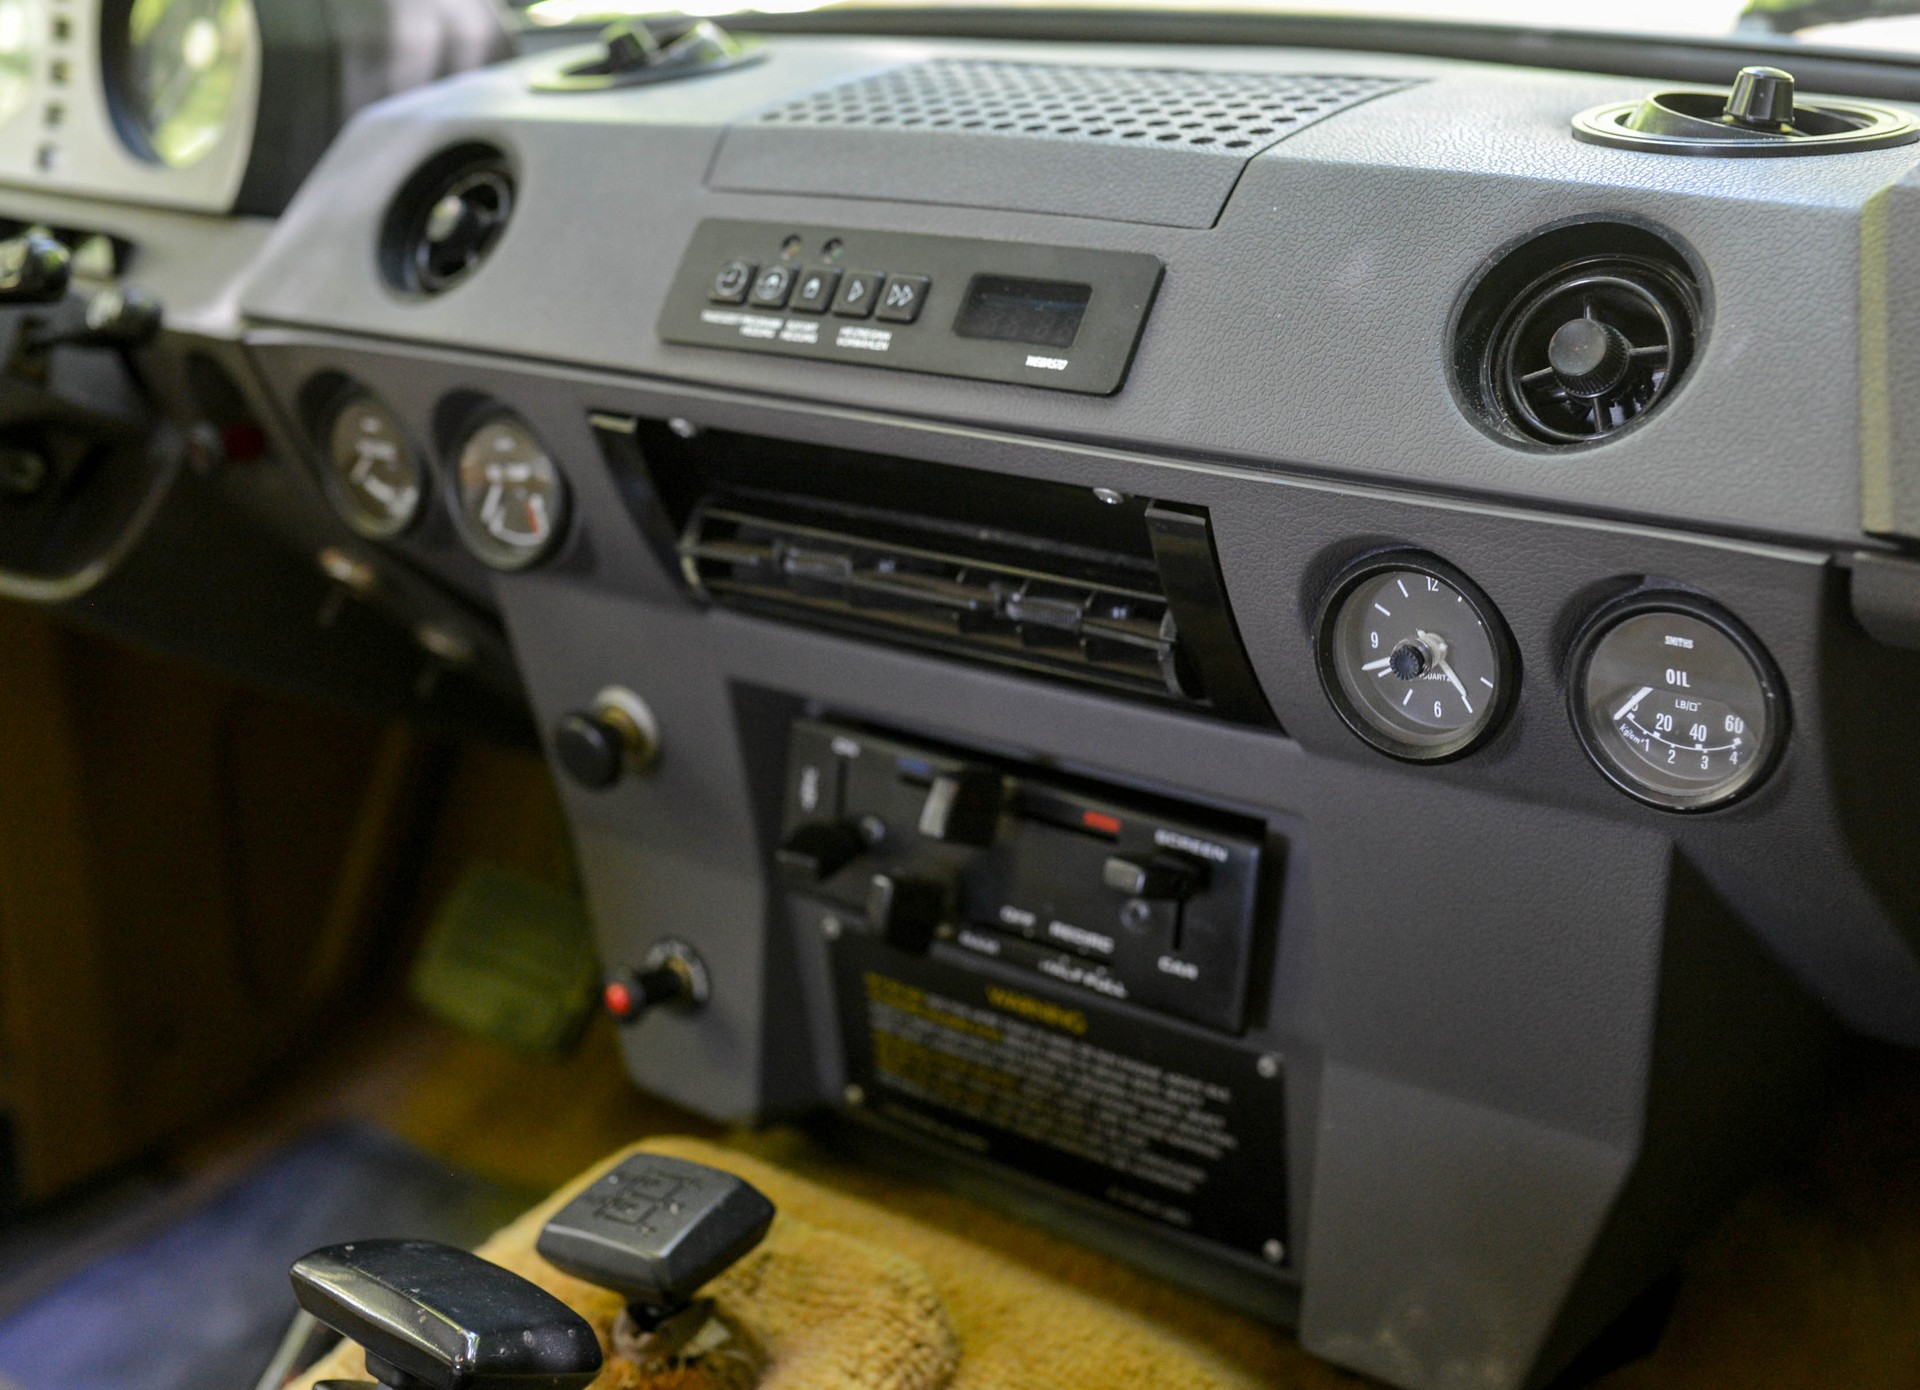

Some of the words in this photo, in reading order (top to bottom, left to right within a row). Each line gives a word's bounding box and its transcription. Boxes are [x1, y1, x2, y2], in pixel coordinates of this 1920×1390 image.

[1426, 576, 1439, 592] 12
[1370, 631, 1379, 648] 9
[1665, 668, 1691, 687] OIL
[1434, 701, 1442, 717] 6
[1655, 713, 1673, 731] 20
[1689, 723, 1707, 742] 40
[1725, 715, 1744, 734] 60
[1644, 739, 1650, 752] 1
[1667, 749, 1676, 764] 2
[1701, 755, 1709, 769] 3
[1729, 751, 1738, 765] 4
[1154, 829, 1228, 862] SCREEN
